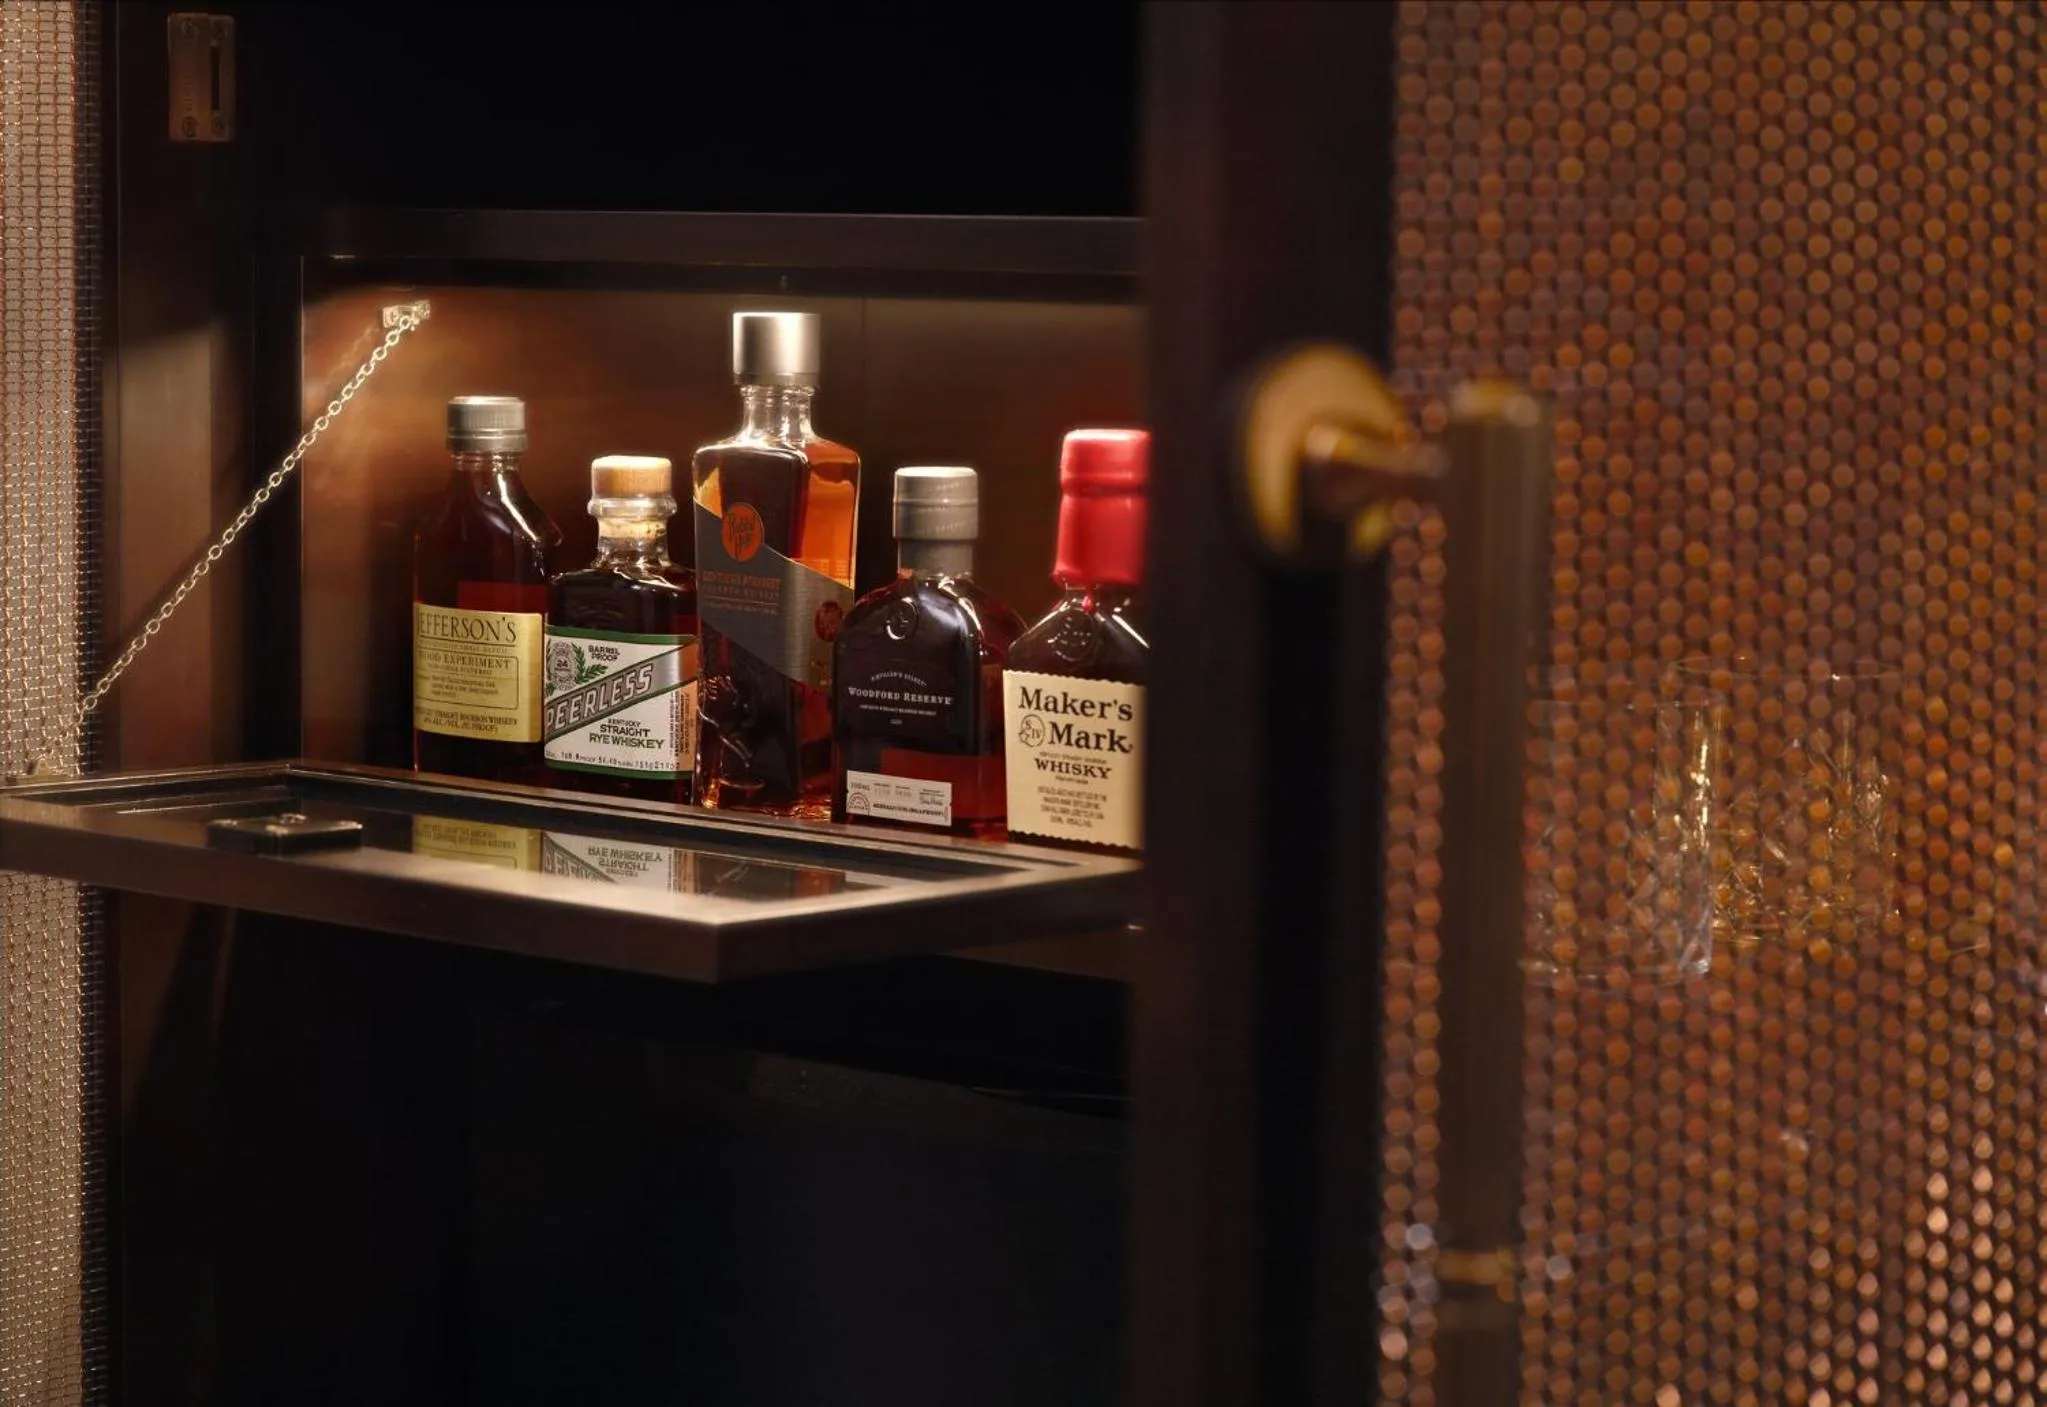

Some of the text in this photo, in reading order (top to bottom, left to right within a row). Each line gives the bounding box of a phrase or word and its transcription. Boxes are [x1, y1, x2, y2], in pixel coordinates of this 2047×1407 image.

[418, 612, 517, 643] EFFERSON'S
[588, 645, 620, 655] BARREL
[444, 654, 510, 669] EXPERIMENT
[545, 663, 654, 730] PEERLESS
[1018, 686, 1133, 721] Maker's
[599, 724, 651, 738] STRAIGHT
[607, 718, 641, 727] KENTUCKY
[589, 732, 665, 749] RYE WHISKEY
[1034, 758, 1112, 780] WHISKY
